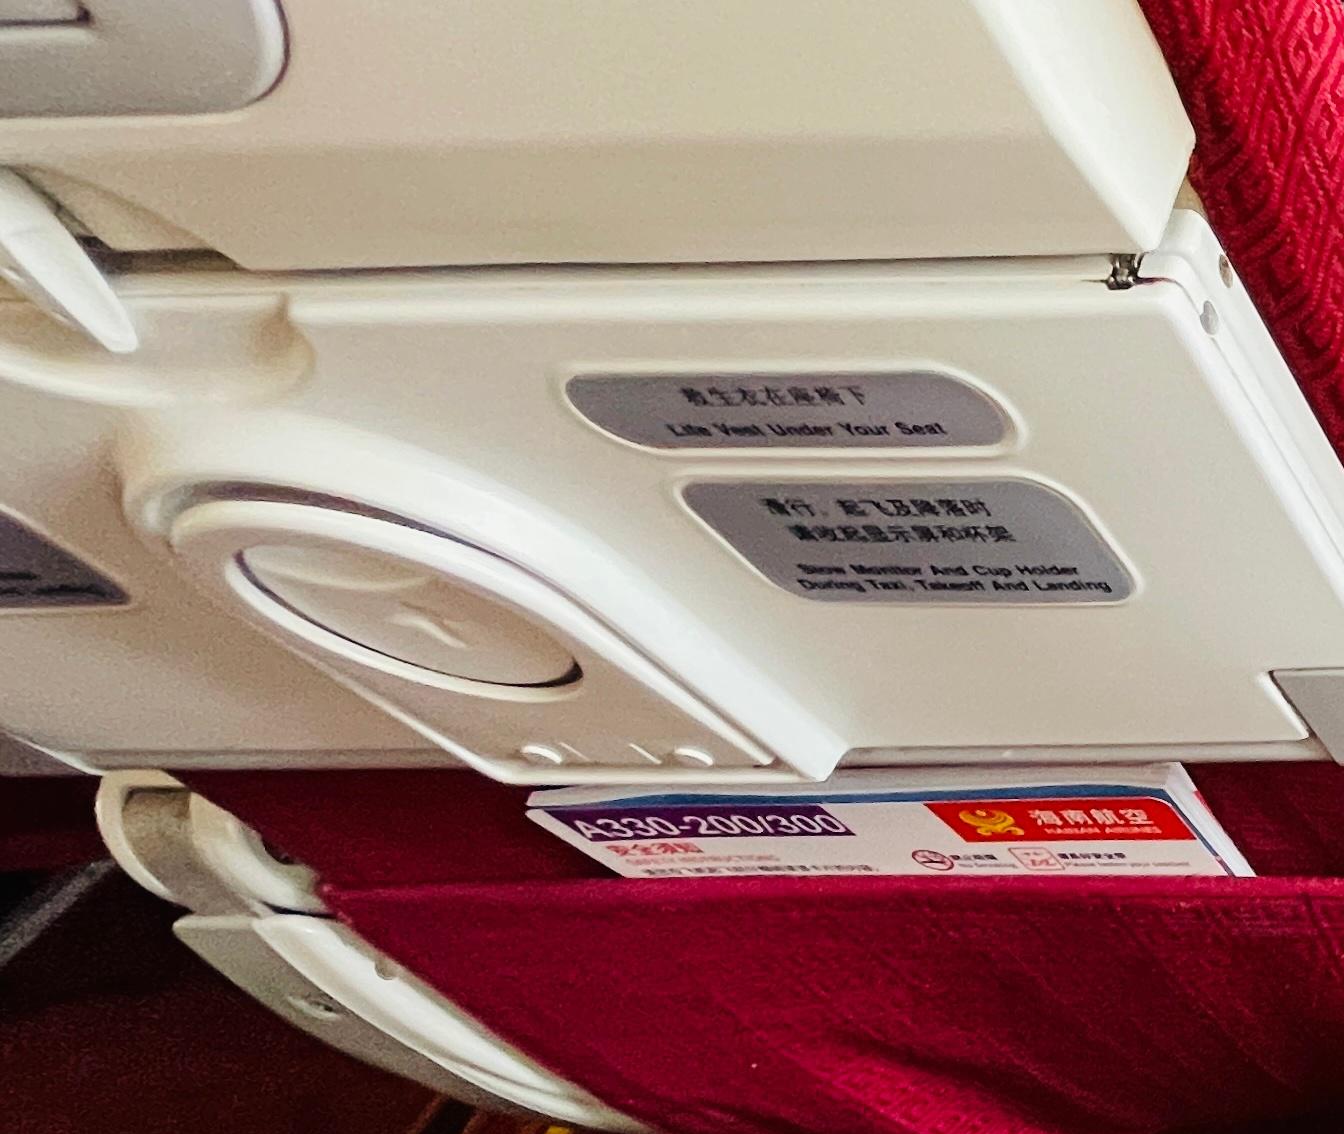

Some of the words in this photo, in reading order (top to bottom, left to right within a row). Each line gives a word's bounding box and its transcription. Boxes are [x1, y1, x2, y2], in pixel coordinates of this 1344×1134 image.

[767, 423, 834, 437] Under
[838, 422, 890, 436] Your
[894, 421, 948, 435] Seat
[930, 564, 968, 576] And
[972, 564, 1013, 578] Cup
[1016, 565, 1079, 576] Holder
[991, 579, 1028, 591] And
[1028, 808, 1154, 826] 海南航空
[573, 814, 848, 840] A330-200/300
